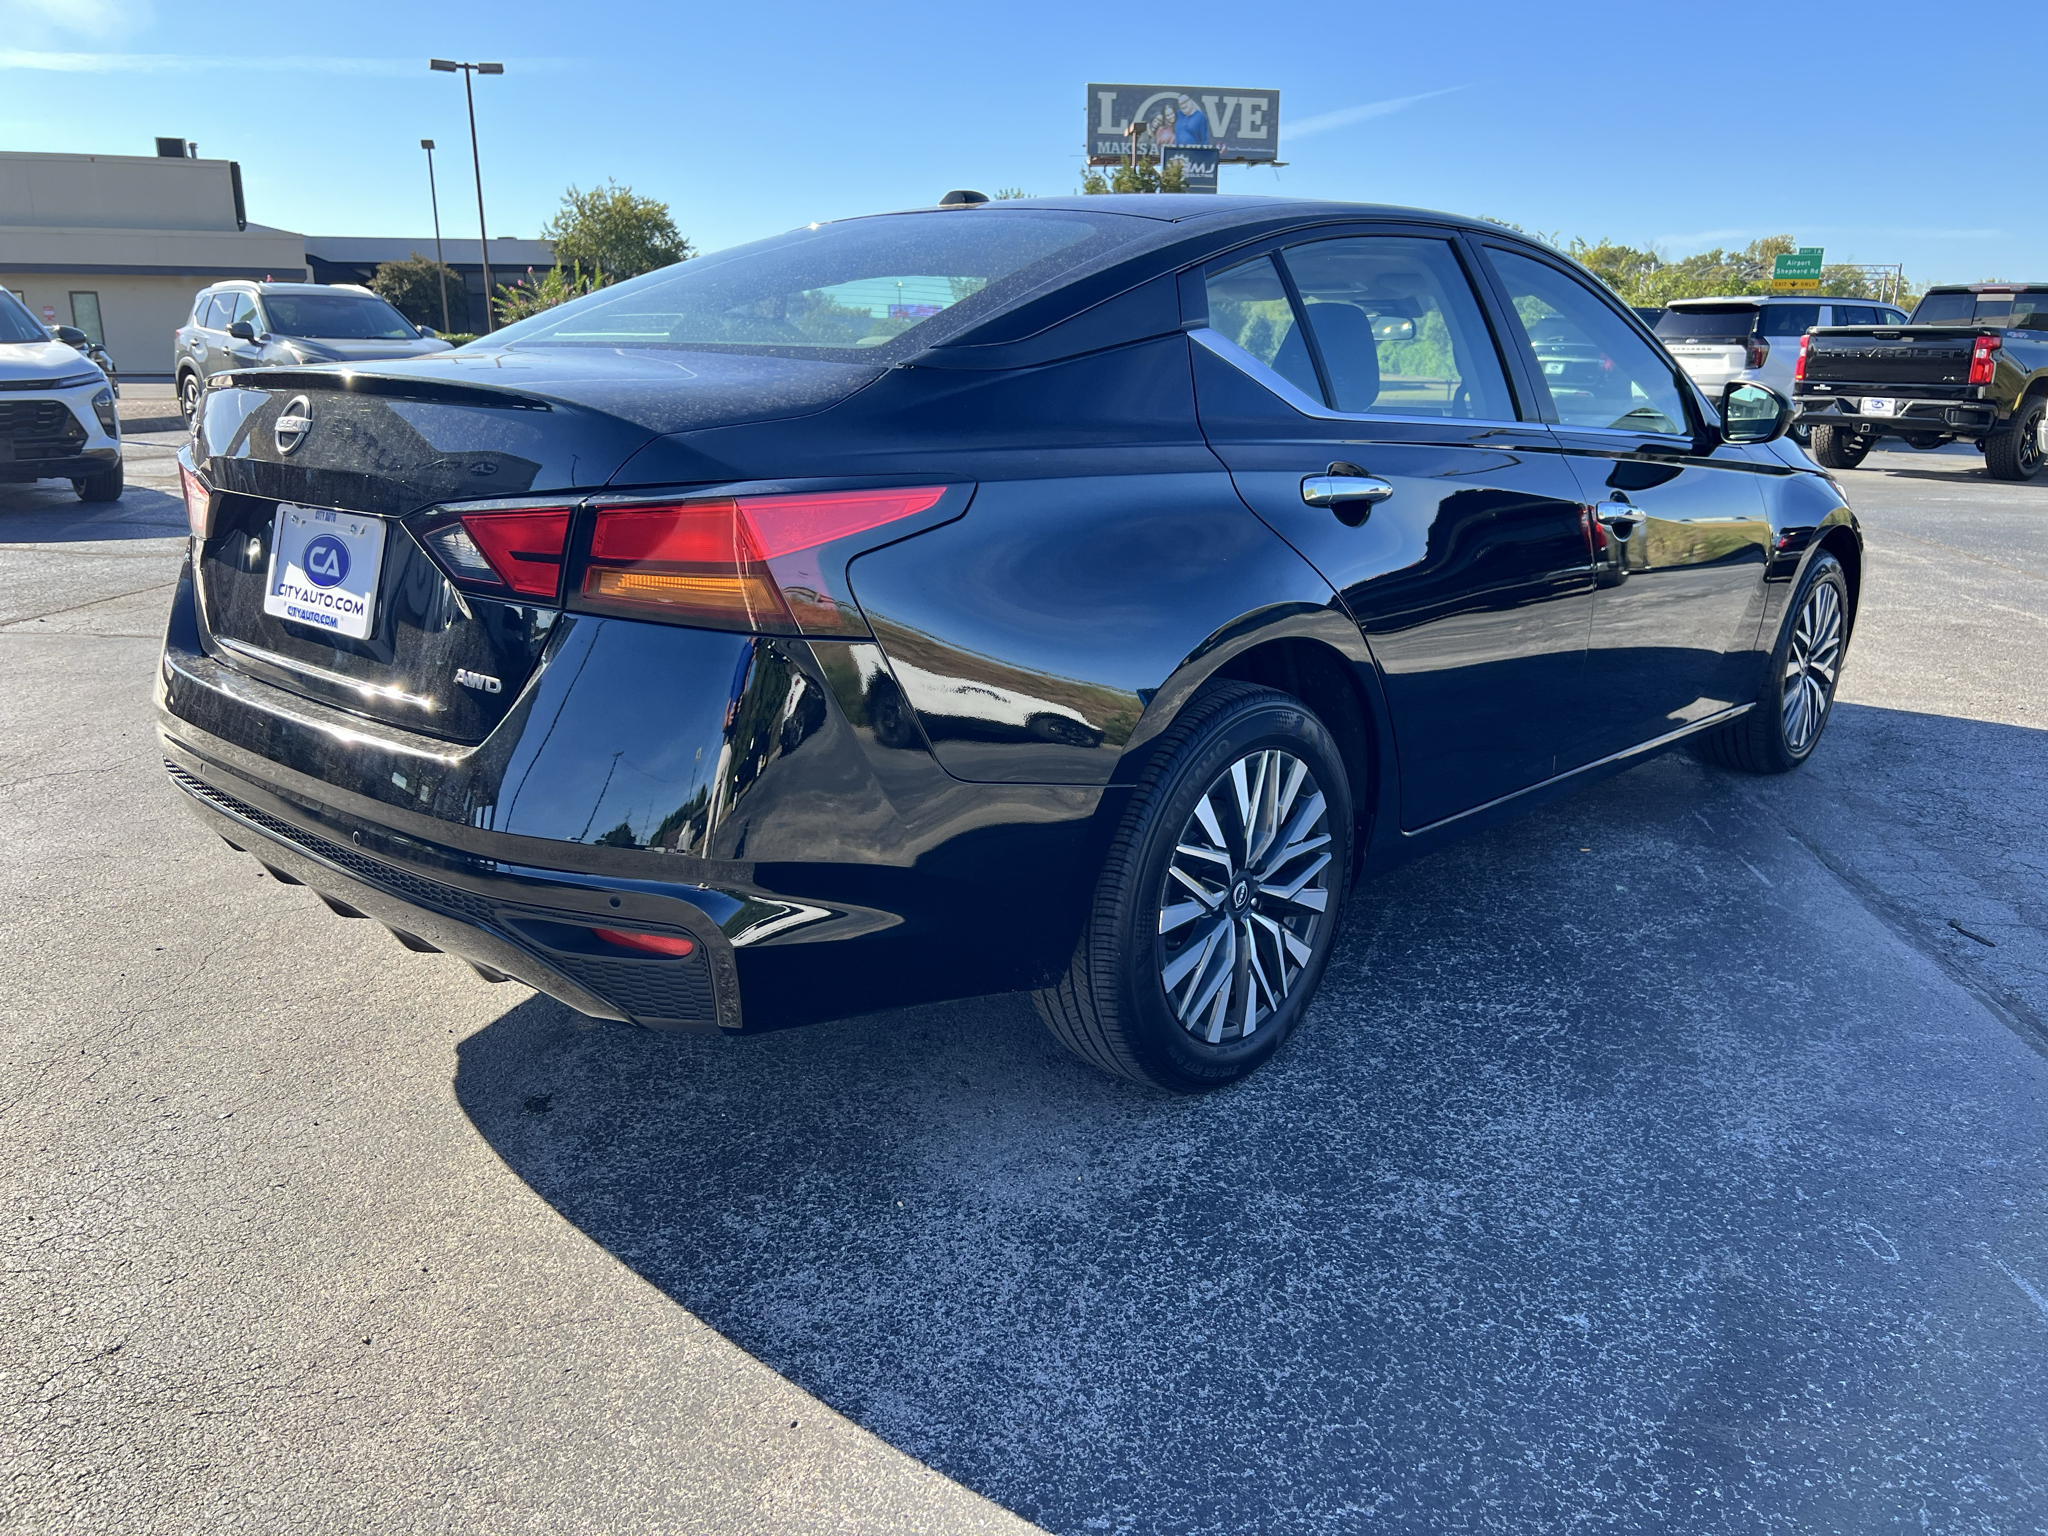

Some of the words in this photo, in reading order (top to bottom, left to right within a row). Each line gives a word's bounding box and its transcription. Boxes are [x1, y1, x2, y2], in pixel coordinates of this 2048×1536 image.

[1786, 259, 1811, 267] Airport
[1816, 348, 1962, 358] CHEVROLET
[315, 510, 325, 520] CITY
[325, 512, 336, 523] AUTO
[309, 546, 340, 578] CA
[278, 583, 364, 616] CITYAUTO.COM
[287, 605, 339, 629] CITYAUTO.COM
[453, 668, 502, 694] AWD
[1165, 739, 1231, 833] KUMHO
